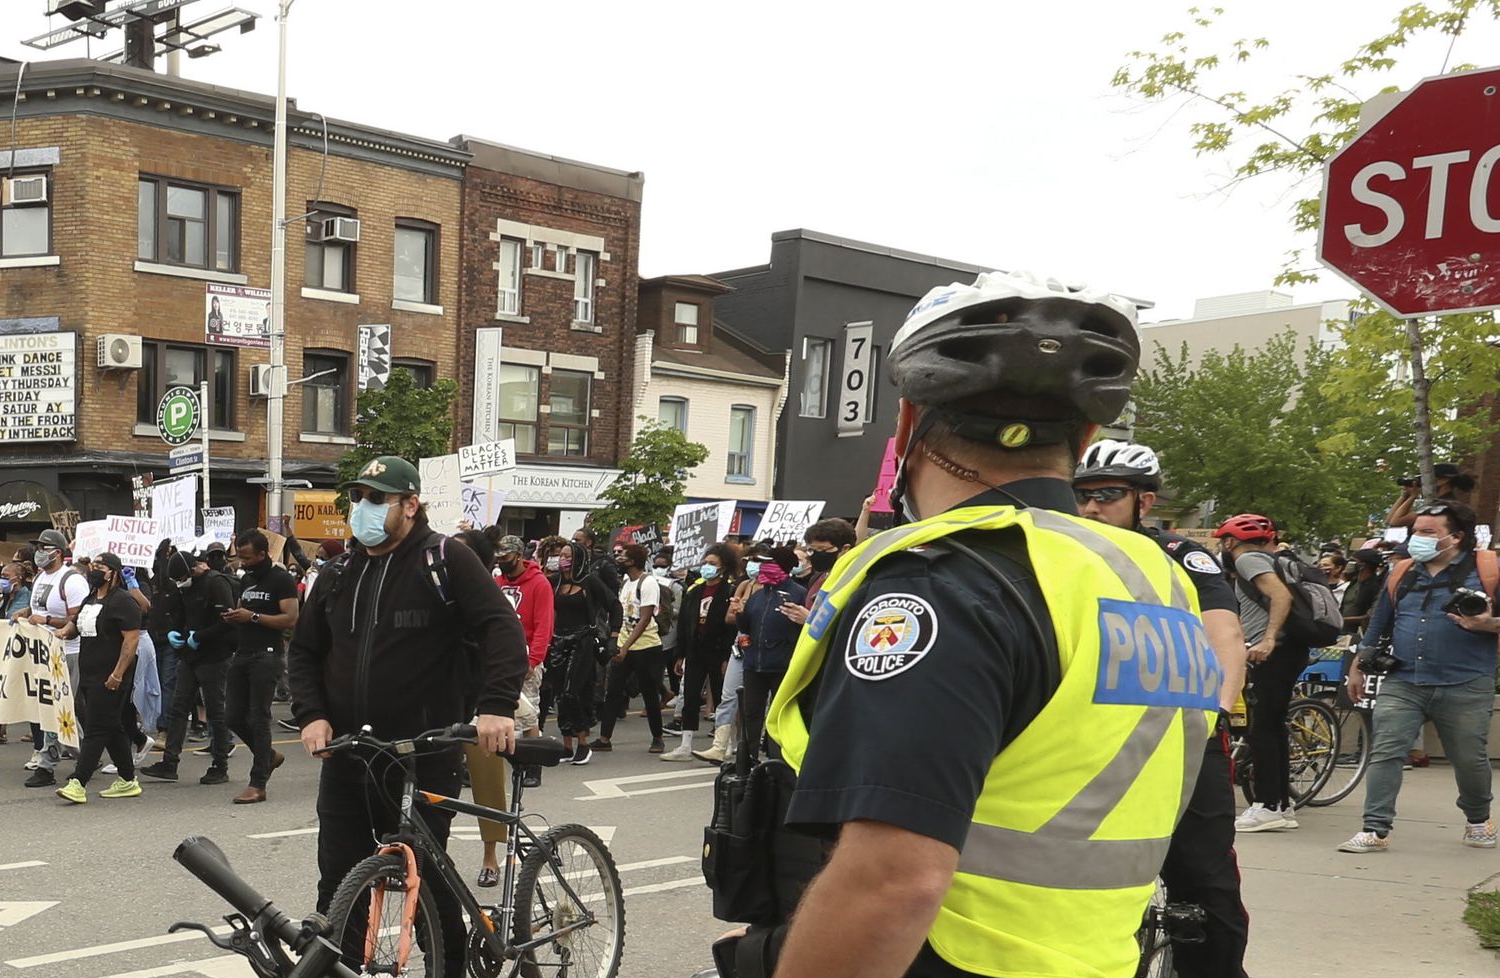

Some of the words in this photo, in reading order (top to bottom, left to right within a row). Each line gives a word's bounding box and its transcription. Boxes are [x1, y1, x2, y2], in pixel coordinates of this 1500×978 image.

[23, 352, 62, 364] DANCE
[11, 377, 69, 390] THURSDAY
[12, 415, 34, 427] THE
[38, 414, 75, 426] FRONT
[171, 402, 187, 426] P
[9, 429, 20, 439] IN
[21, 428, 42, 439] THE
[44, 426, 74, 438] BACK
[462, 442, 501, 459] BLACK
[472, 449, 507, 464] LIVES
[175, 456, 193, 466] Clinton
[464, 457, 508, 472] MATTER
[512, 475, 528, 485] THE
[529, 475, 559, 487] KOREAN
[561, 477, 593, 488] KITCHEN
[158, 483, 183, 509] WE
[107, 518, 158, 535] JUSTICE
[677, 513, 691, 530] All
[107, 541, 153, 557] REGIS
[861, 598, 925, 621] TORONTO
[1102, 611, 1218, 699] POLIC
[857, 654, 906, 674] POLICE
